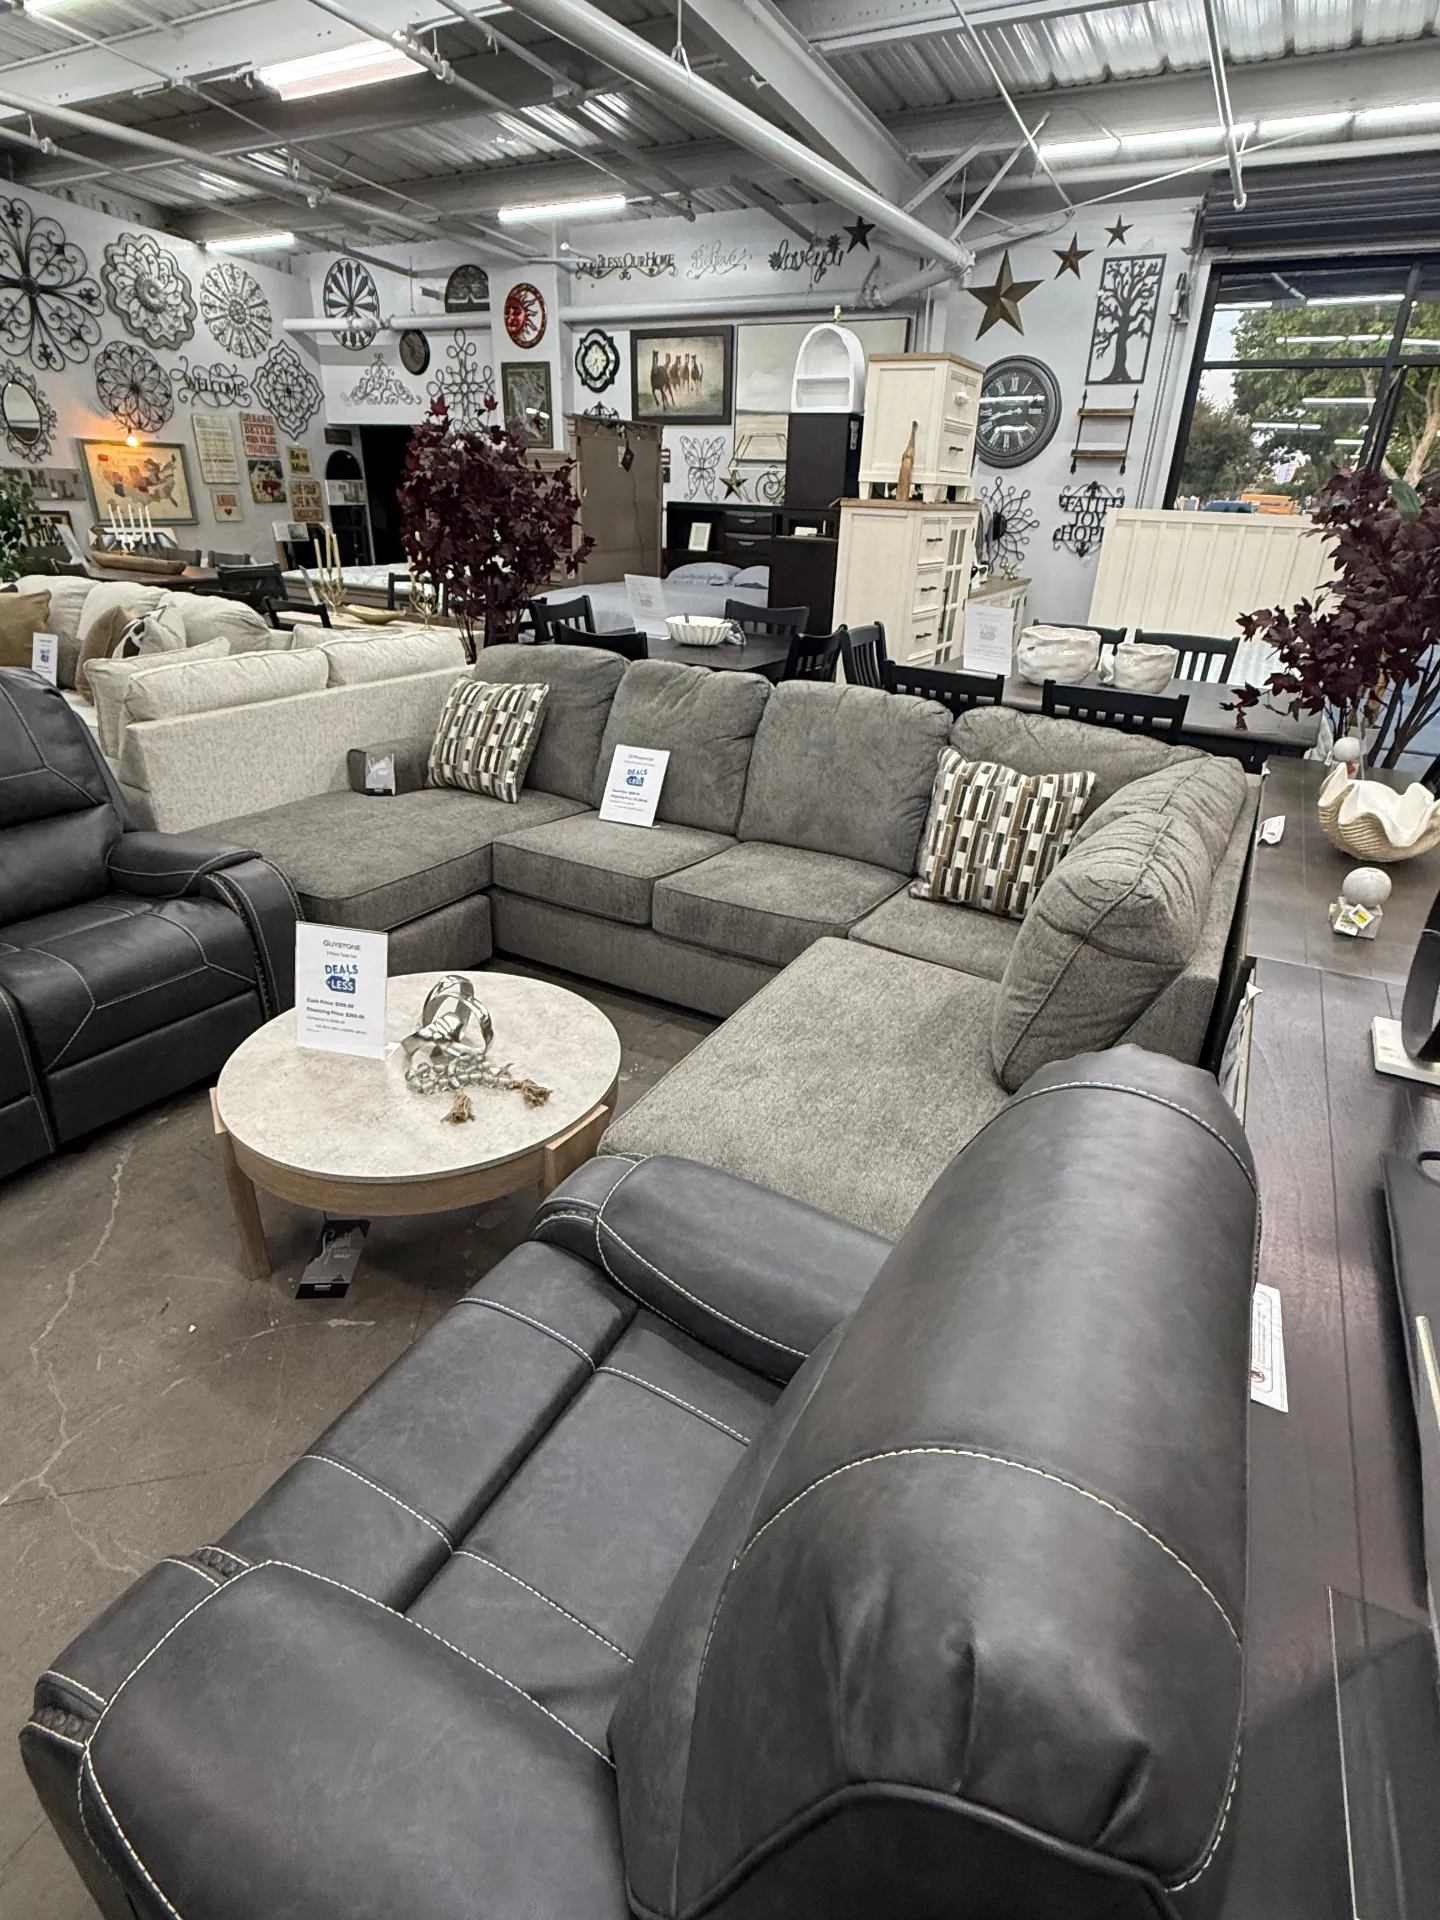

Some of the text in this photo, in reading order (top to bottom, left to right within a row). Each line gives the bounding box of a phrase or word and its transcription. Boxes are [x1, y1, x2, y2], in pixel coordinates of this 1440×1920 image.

[1069, 511, 1107, 527] JOY
[324, 964, 359, 974] DEALS
[331, 979, 354, 991] LESS
[306, 1007, 330, 1016] Financing
